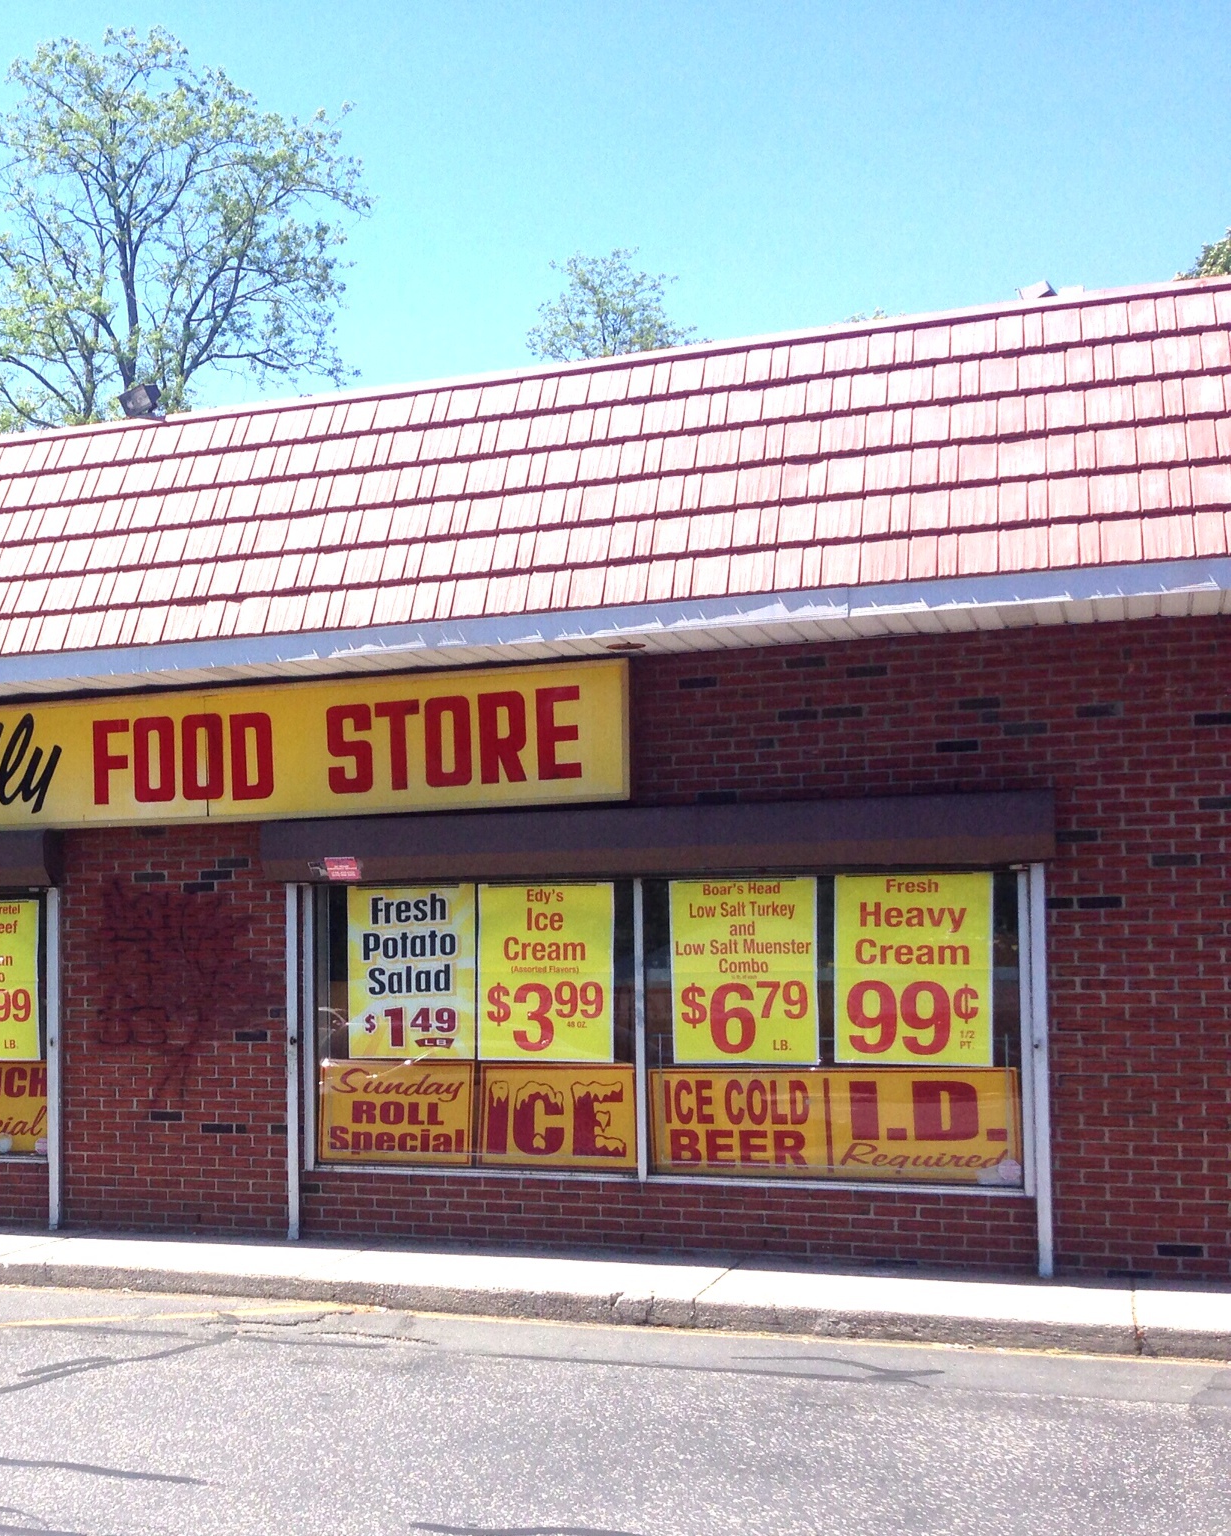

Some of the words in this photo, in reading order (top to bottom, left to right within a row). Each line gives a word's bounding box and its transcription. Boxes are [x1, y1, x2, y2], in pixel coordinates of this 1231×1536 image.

[92, 711, 275, 806] FOOD
[327, 685, 583, 793] STORE
[527, 889, 563, 904] Edy's
[702, 884, 744, 896] Boar's
[748, 883, 781, 895] Head
[885, 879, 939, 893] Fresh
[371, 893, 446, 925] Fresh
[527, 908, 563, 931] Ice
[689, 903, 716, 919] Low
[721, 902, 748, 918] Salt
[750, 902, 796, 920] Turkey
[859, 902, 967, 933] Heavy
[729, 922, 756, 936] and
[363, 930, 456, 961] Potato
[503, 937, 586, 962] Cream
[675, 941, 706, 955] Low
[710, 940, 739, 955] Salt
[743, 939, 812, 955] Muenster
[855, 938, 970, 965] Cream
[511, 966, 547, 975] (Assorted
[549, 966, 579, 975] Flavors)
[719, 959, 769, 974] Combo
[369, 964, 451, 996] Salad
[425, 1039, 447, 1047] LB
[773, 1040, 792, 1051] LB.
[331, 1068, 465, 1102] Sunday
[352, 1101, 444, 1125] ROLL
[665, 1079, 715, 1125] ICE
[724, 1079, 810, 1125] COLD
[849, 1080, 1007, 1142] I.D.
[487, 1080, 627, 1158] ICE
[330, 1126, 464, 1156] Special
[670, 1128, 810, 1170] BEER
[841, 1142, 1009, 1175] Required
